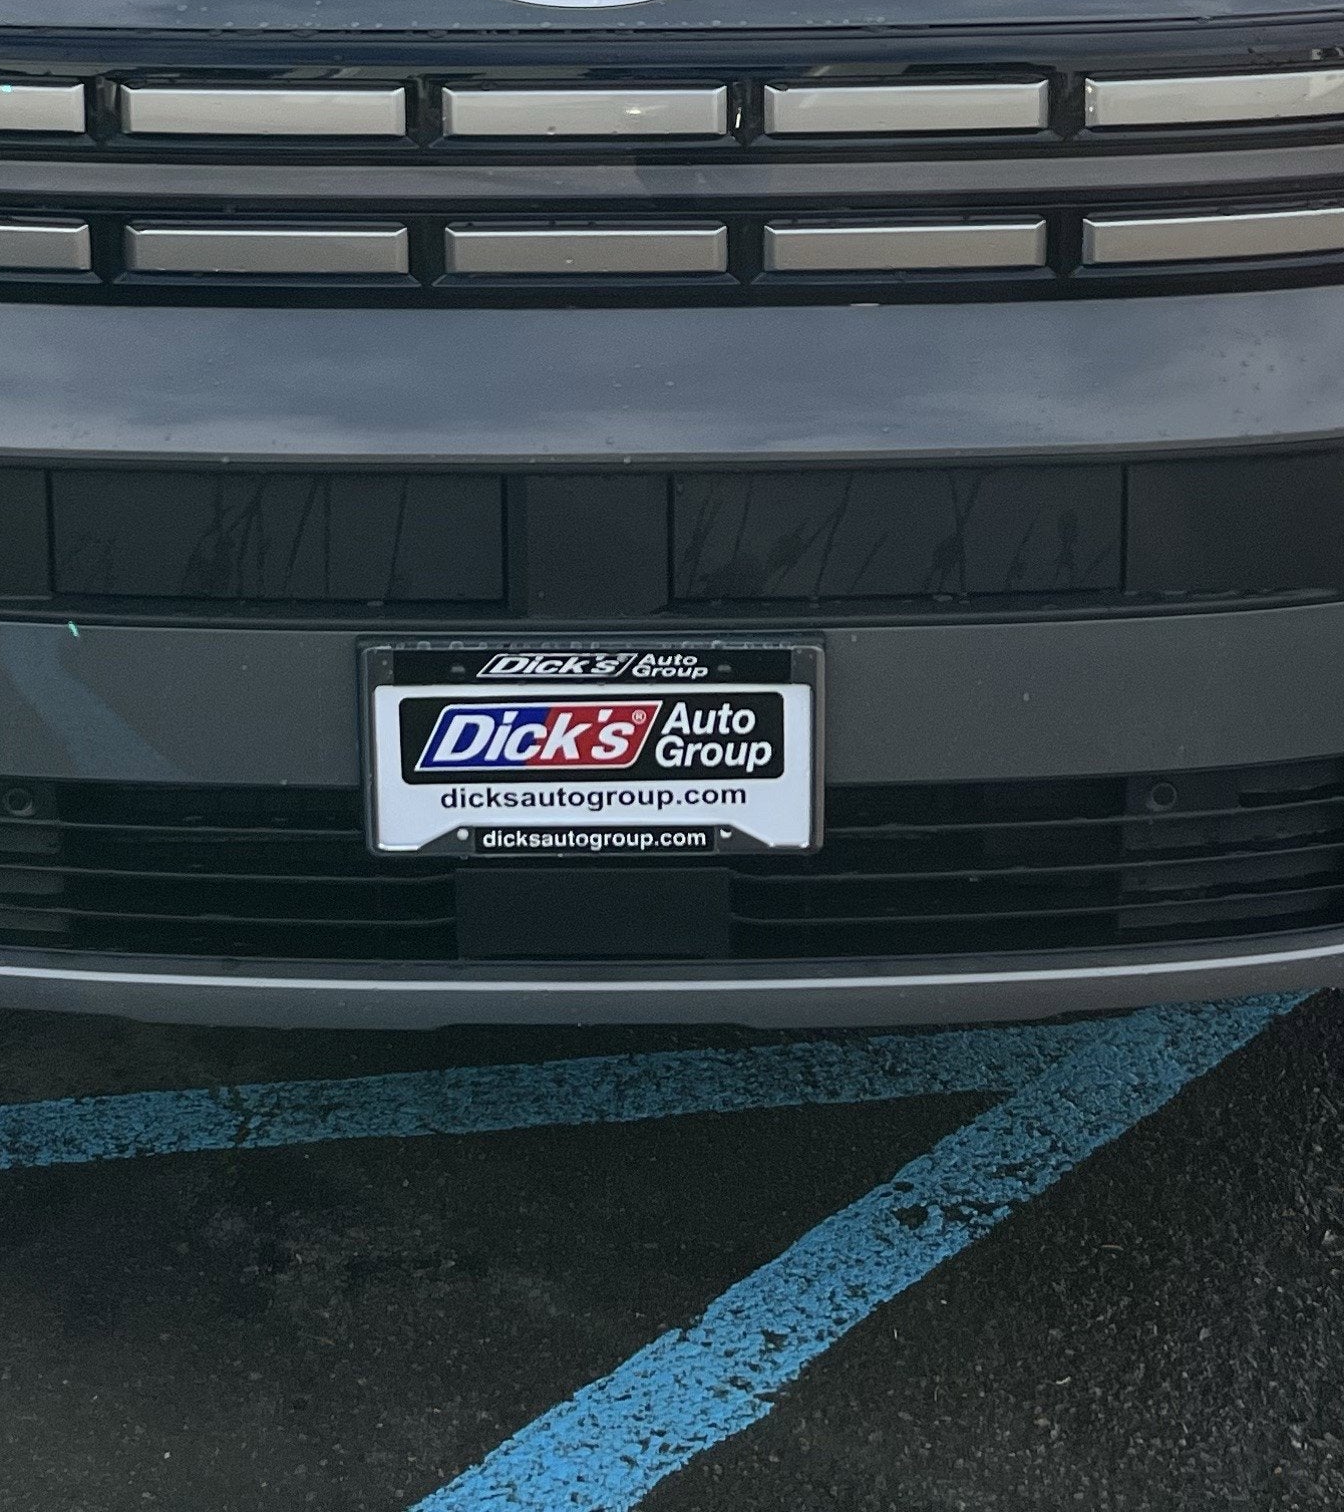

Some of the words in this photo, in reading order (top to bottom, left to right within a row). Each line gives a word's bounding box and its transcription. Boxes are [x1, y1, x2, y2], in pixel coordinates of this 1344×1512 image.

[632, 665, 709, 679] Group
[639, 653, 698, 667] Auto
[661, 701, 755, 735] Auto
[655, 734, 772, 772] Group
[440, 787, 747, 812] dicksautogroup.com
[482, 828, 707, 851] dicksautogroup.com
